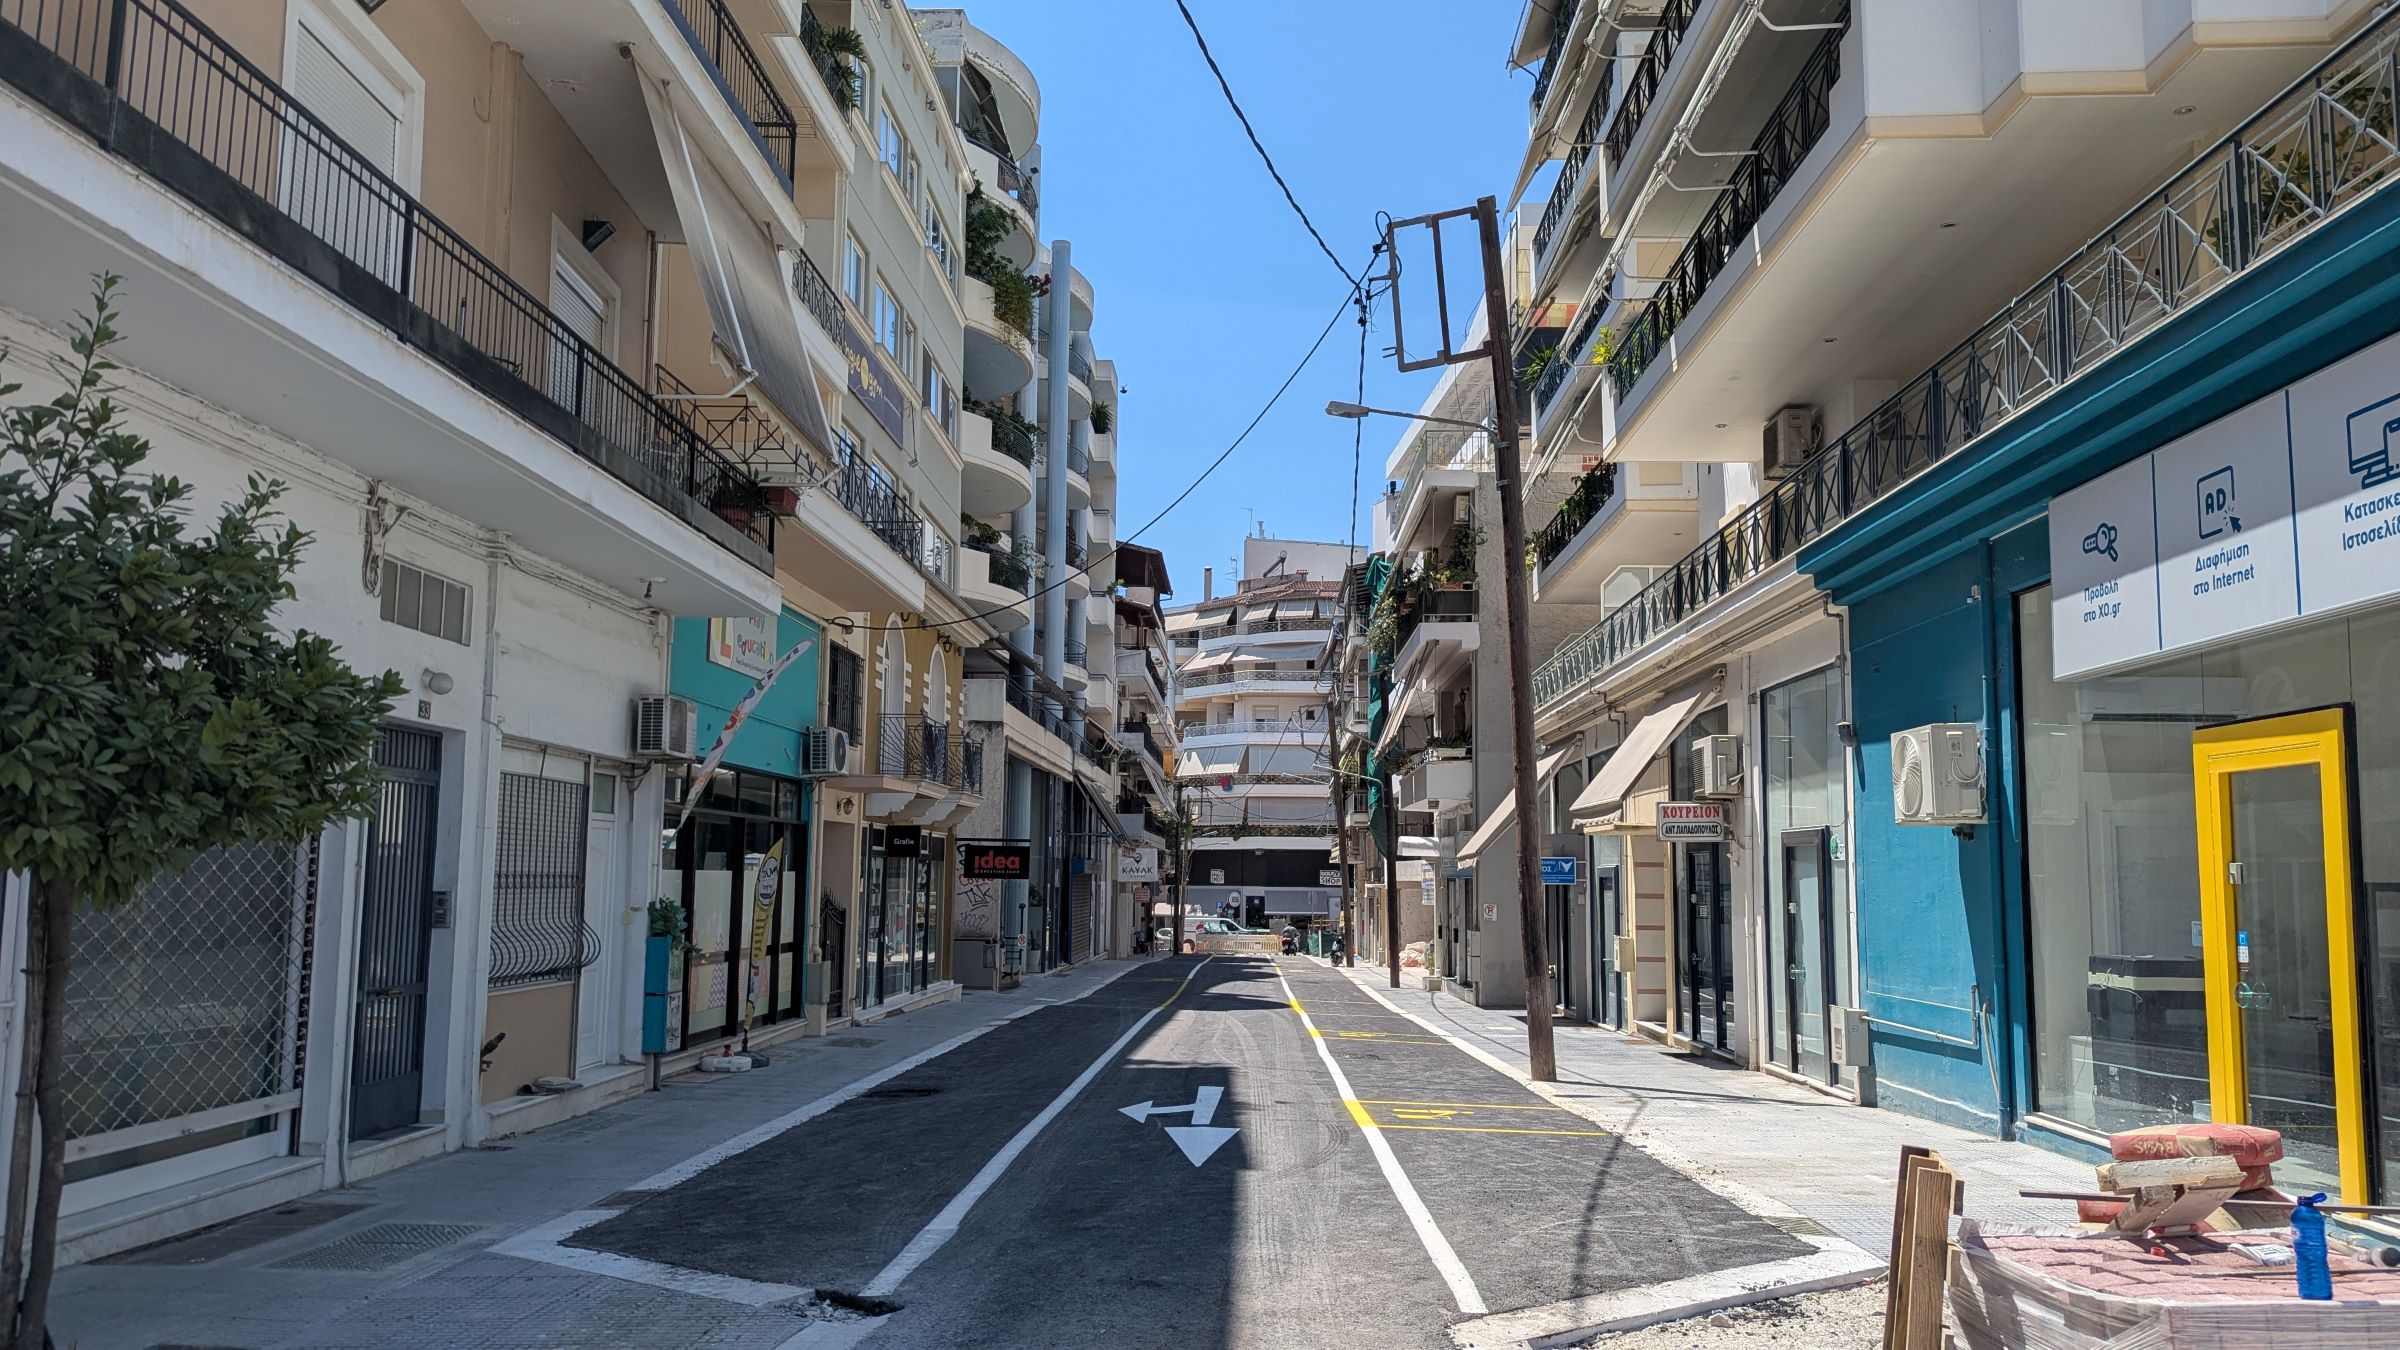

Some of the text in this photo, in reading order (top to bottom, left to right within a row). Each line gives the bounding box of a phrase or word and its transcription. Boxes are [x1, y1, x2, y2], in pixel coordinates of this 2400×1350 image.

[2205, 488, 2226, 515] AD
[2195, 543, 2250, 572] Διαφήμιση
[2084, 578, 2119, 602] Προβολή
[2193, 564, 2255, 596] στο Internet
[2083, 606, 2097, 623] στο
[1663, 806, 1720, 818] ΚΟΥΡΕΙΟΝ
